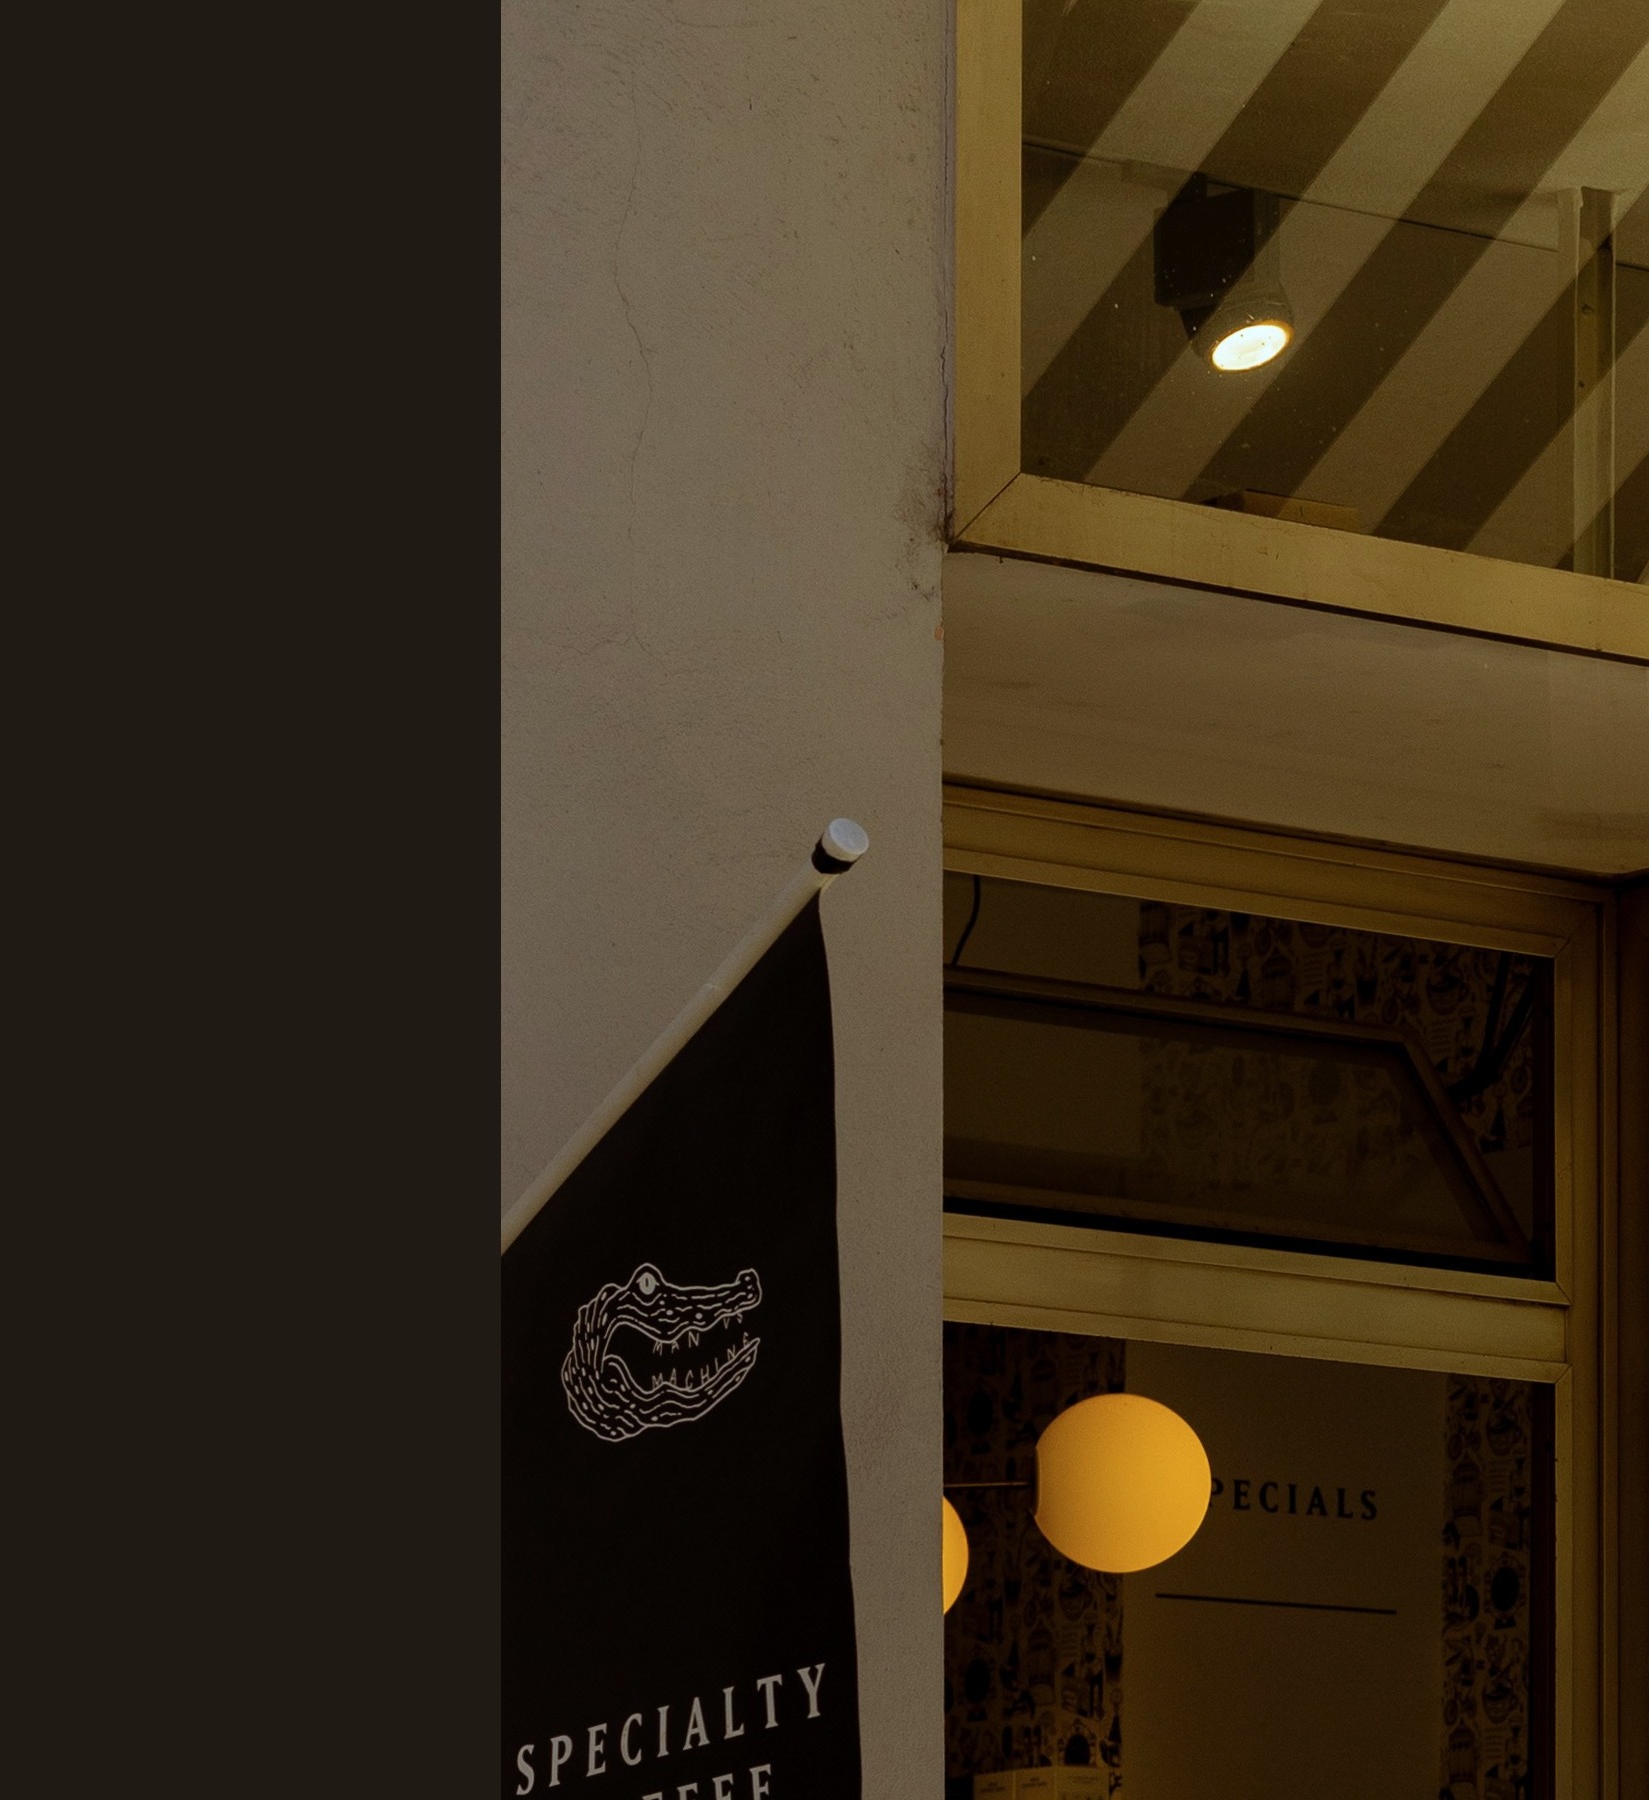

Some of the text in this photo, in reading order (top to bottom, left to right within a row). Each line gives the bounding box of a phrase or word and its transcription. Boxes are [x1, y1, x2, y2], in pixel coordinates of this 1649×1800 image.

[651, 1331, 750, 1391] MACHINE
[653, 1330, 700, 1357] MAN
[1211, 1477, 1378, 1521] PECIALS
[515, 1662, 827, 1797] SPECIALTY
